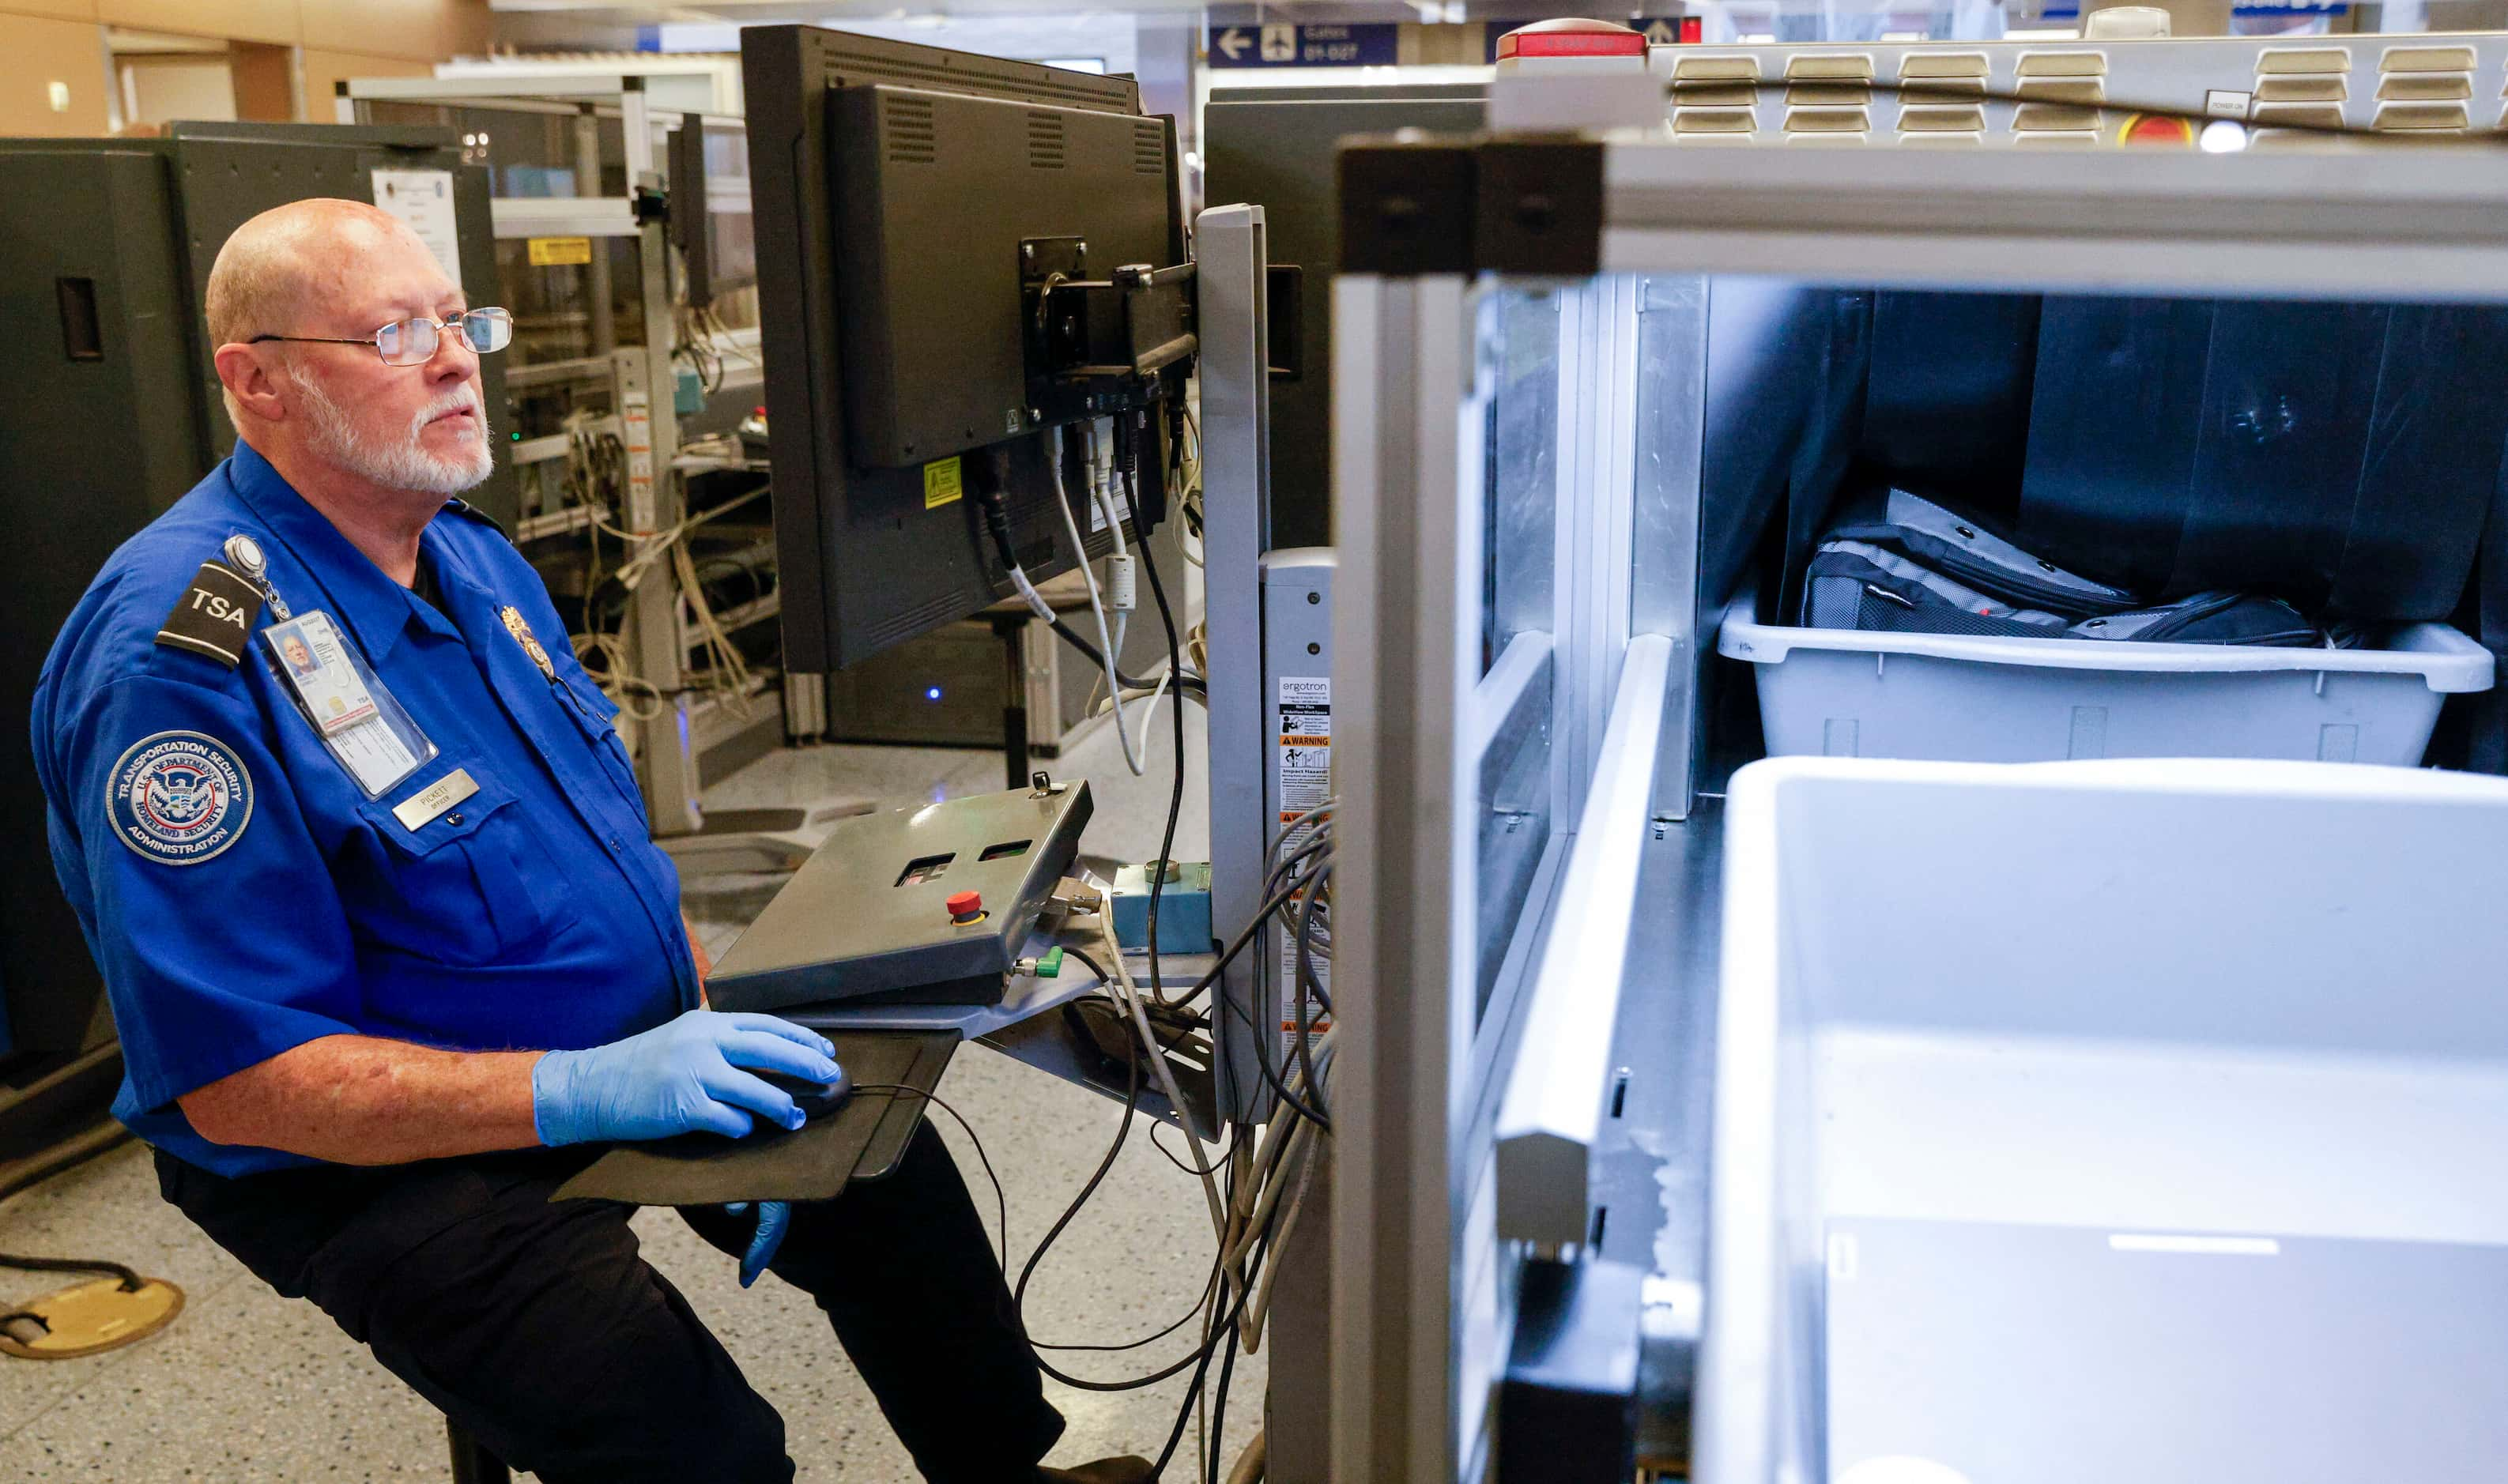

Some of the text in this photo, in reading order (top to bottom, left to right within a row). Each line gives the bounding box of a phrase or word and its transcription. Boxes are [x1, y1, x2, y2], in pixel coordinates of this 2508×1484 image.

[191, 587, 245, 631] TSA
[1283, 683, 1327, 691] ergotron
[1292, 736, 1328, 745] WARNING
[118, 741, 243, 802] TRANSPORTATION SECURITY
[153, 758, 217, 781] DEPARTMENT
[213, 781, 224, 793] OF
[420, 785, 448, 805] PICKETT
[431, 795, 450, 809] OFFICER
[136, 801, 223, 838] HOMELAND SECURITY
[127, 826, 228, 853] ADMINISTRATION
